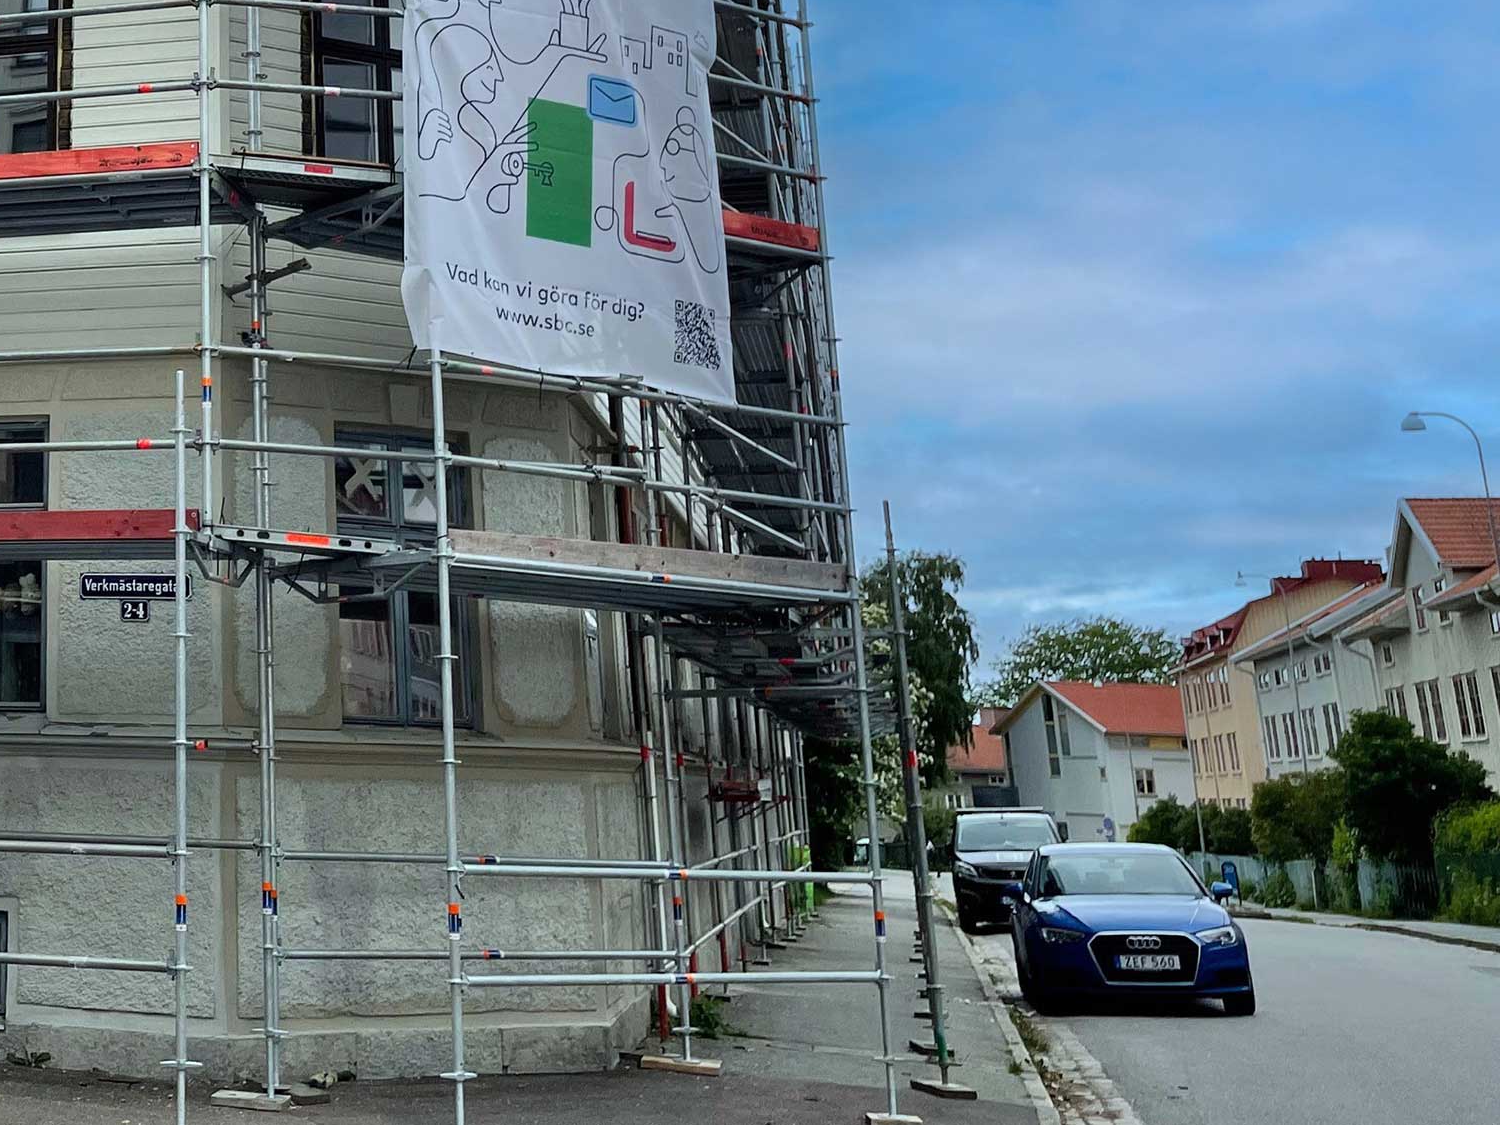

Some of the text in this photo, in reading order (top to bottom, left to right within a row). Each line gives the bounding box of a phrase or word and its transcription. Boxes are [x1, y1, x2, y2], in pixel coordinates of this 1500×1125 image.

[446, 262, 645, 322] Vad kan vi göra för dig?
[496, 306, 595, 337] www.sbc.se
[85, 578, 177, 595] Verkmästaregata
[123, 602, 144, 618] 2-4
